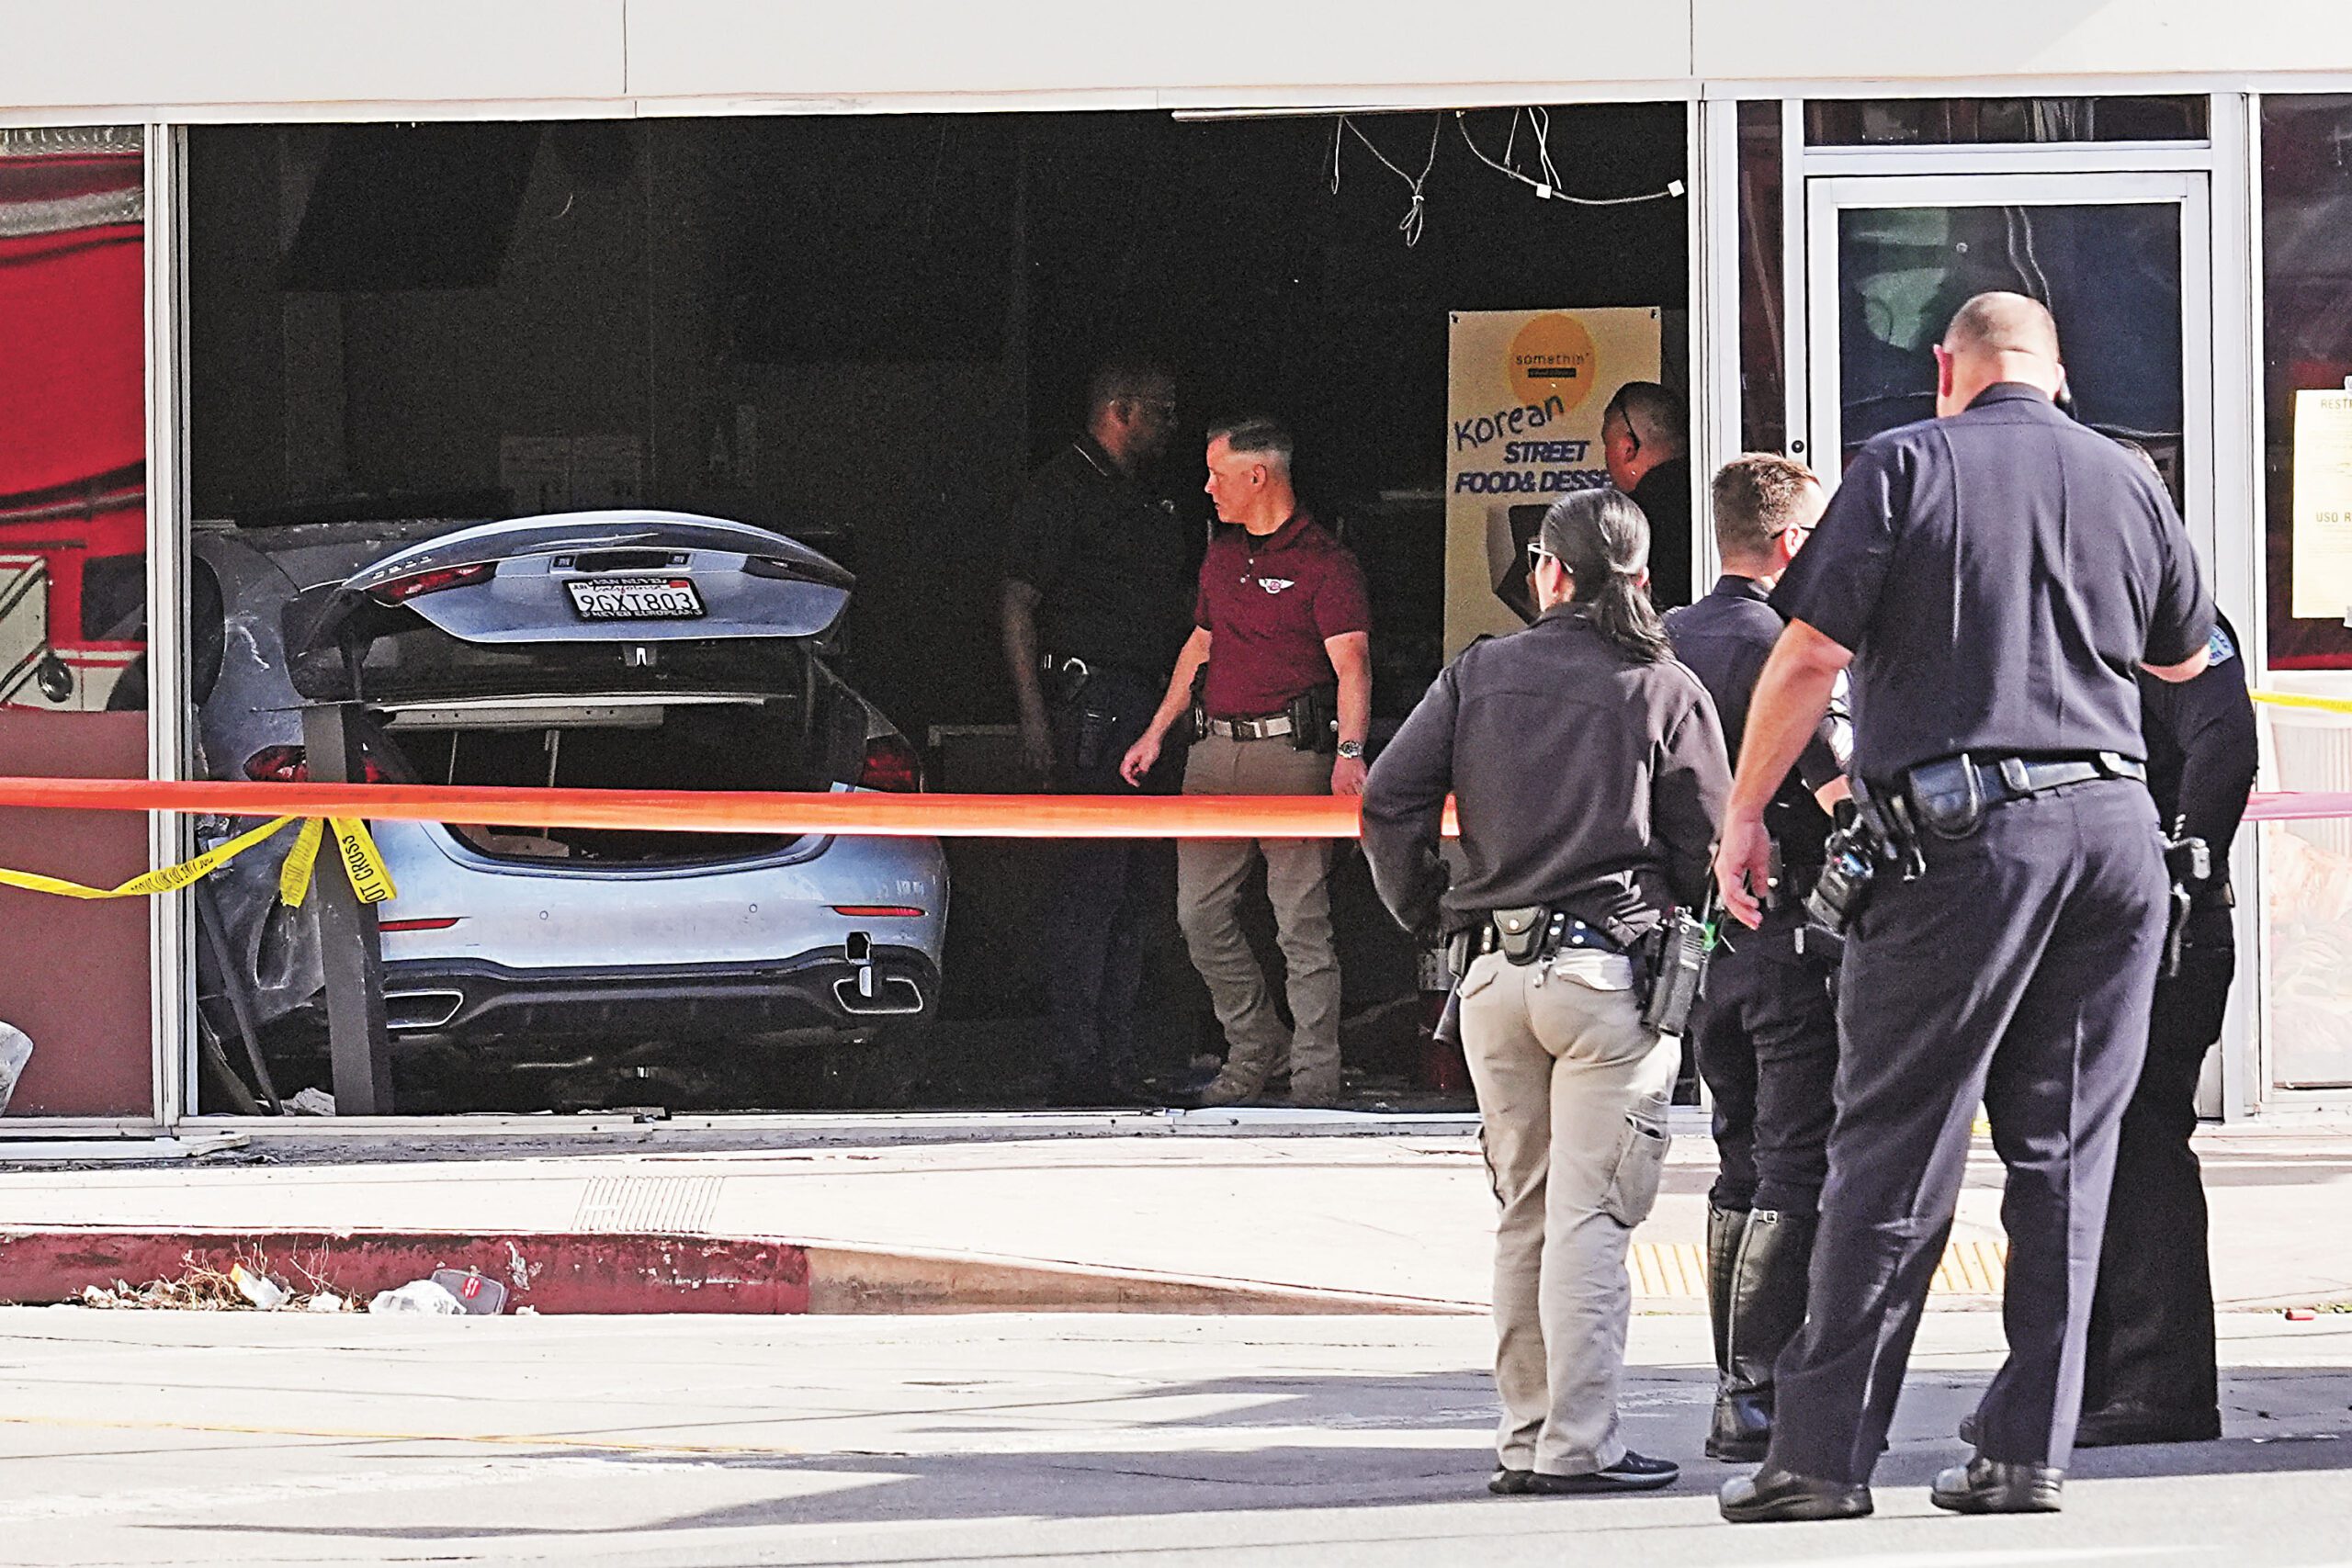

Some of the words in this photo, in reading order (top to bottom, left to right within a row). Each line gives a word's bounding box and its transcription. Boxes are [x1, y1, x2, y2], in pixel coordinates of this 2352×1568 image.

[1454, 395, 1565, 451] Korean
[1504, 440, 1591, 464] STREET
[580, 592, 693, 612] 9GXT803
[342, 835, 374, 881] CROSS
